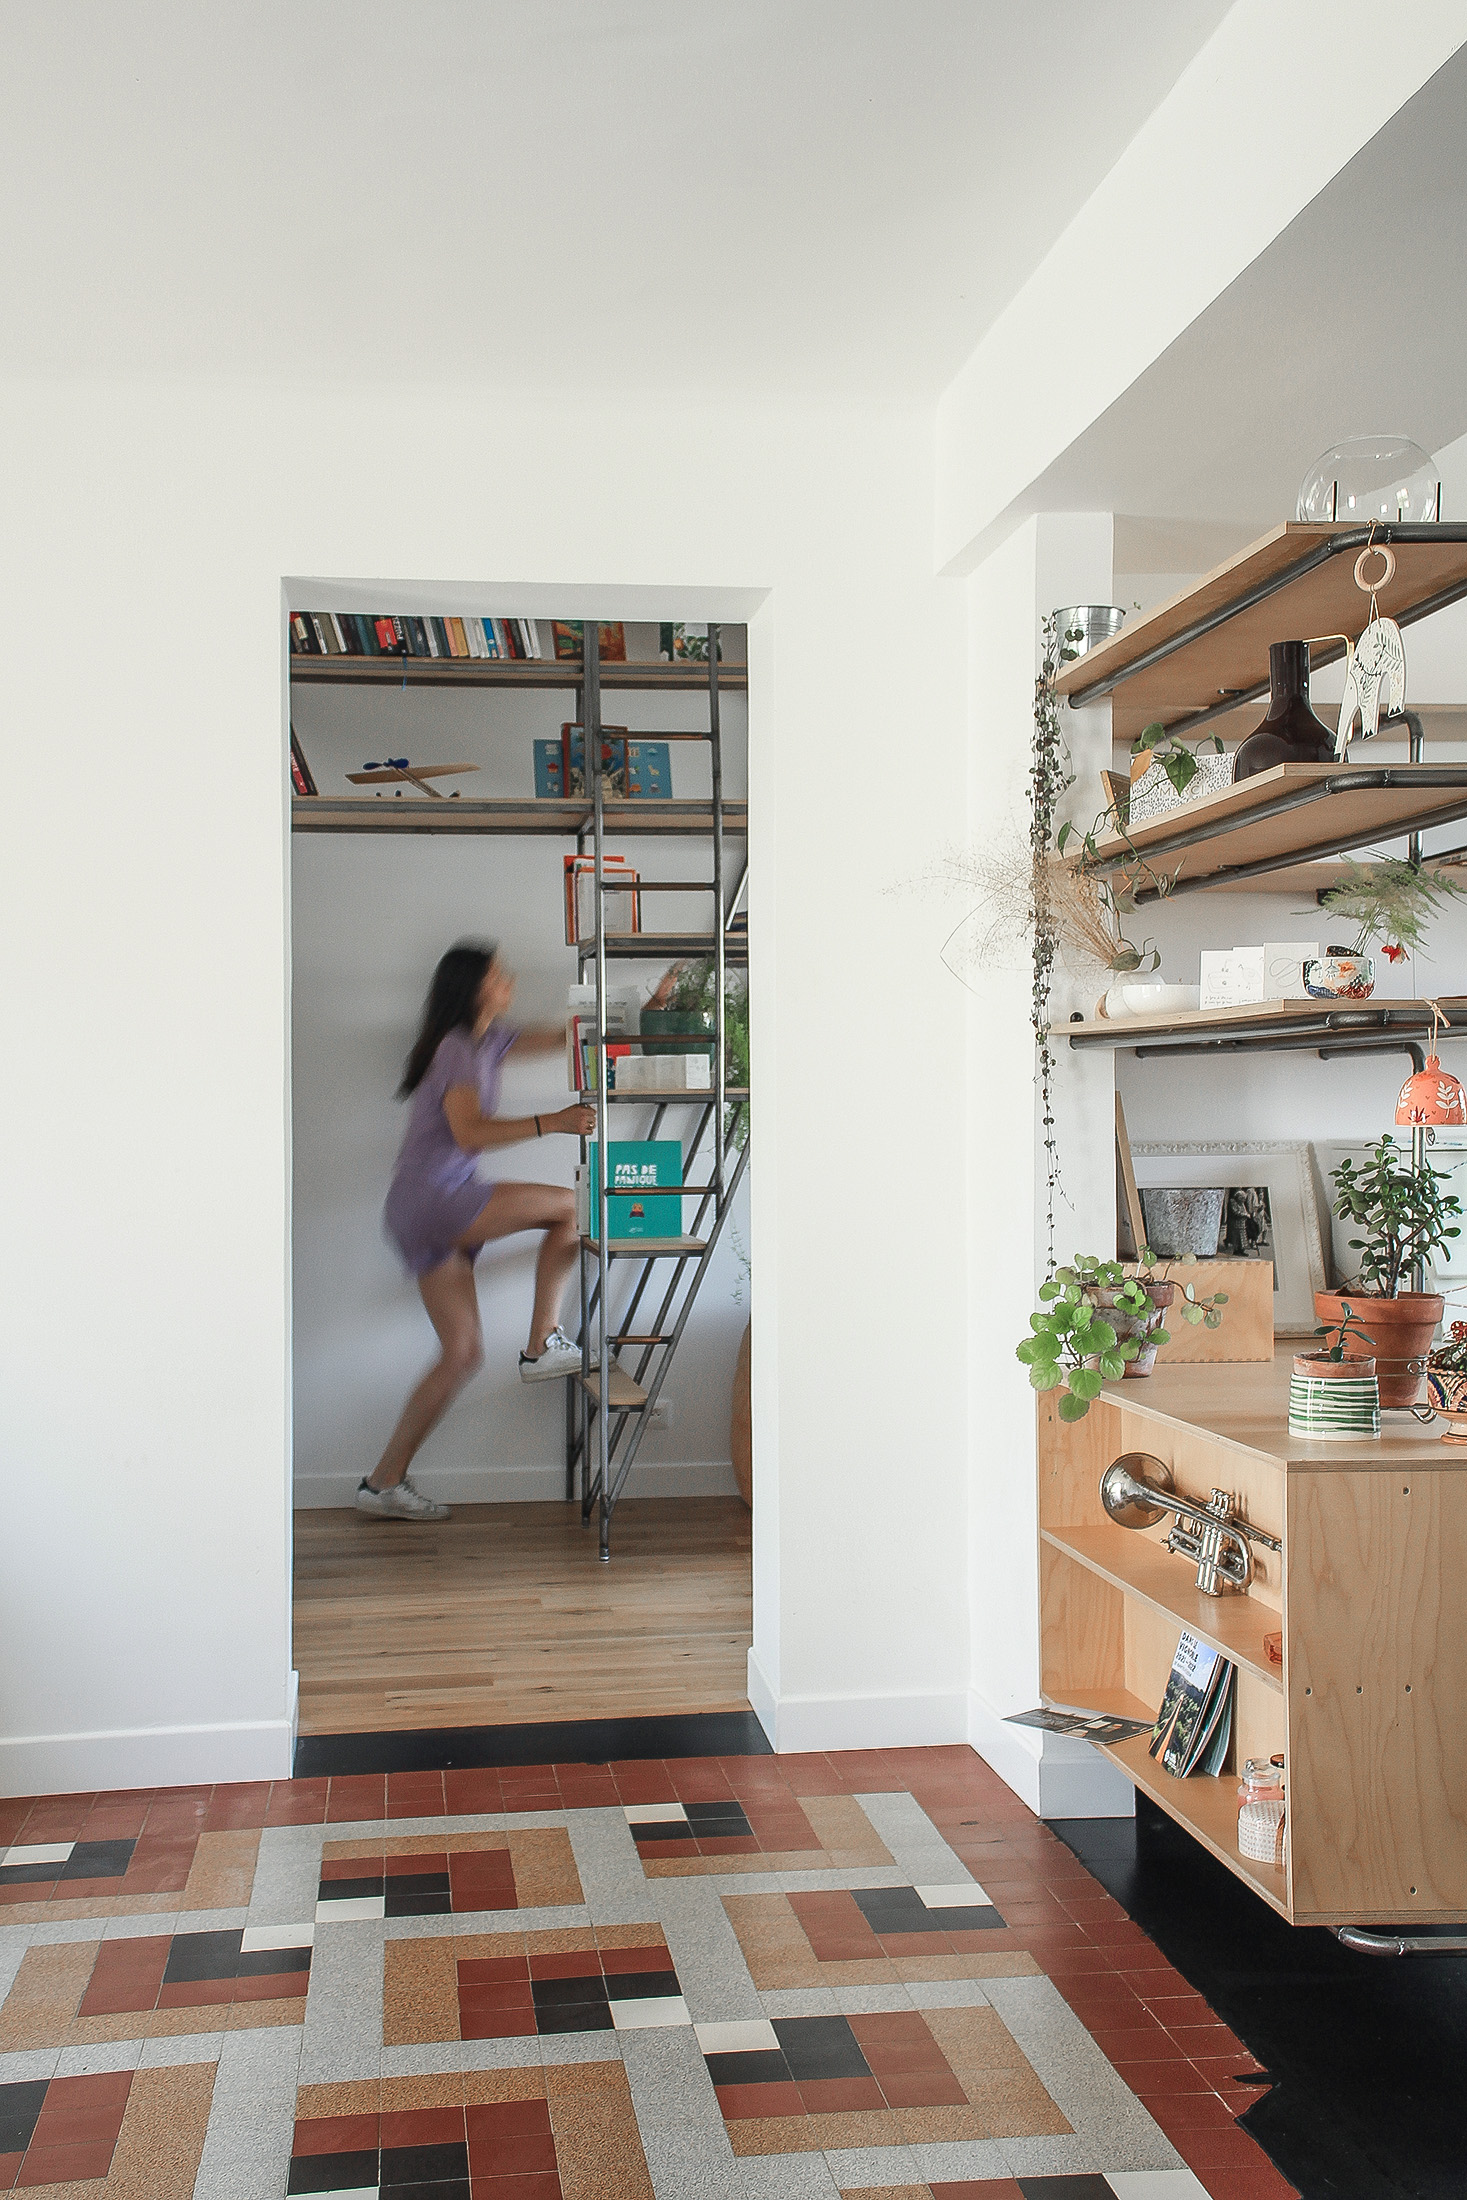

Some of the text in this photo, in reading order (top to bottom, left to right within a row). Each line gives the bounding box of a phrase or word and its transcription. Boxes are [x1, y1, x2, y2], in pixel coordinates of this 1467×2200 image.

[615, 1164, 657, 1175] PAS DE
[614, 1175, 658, 1186] PANIQUE
